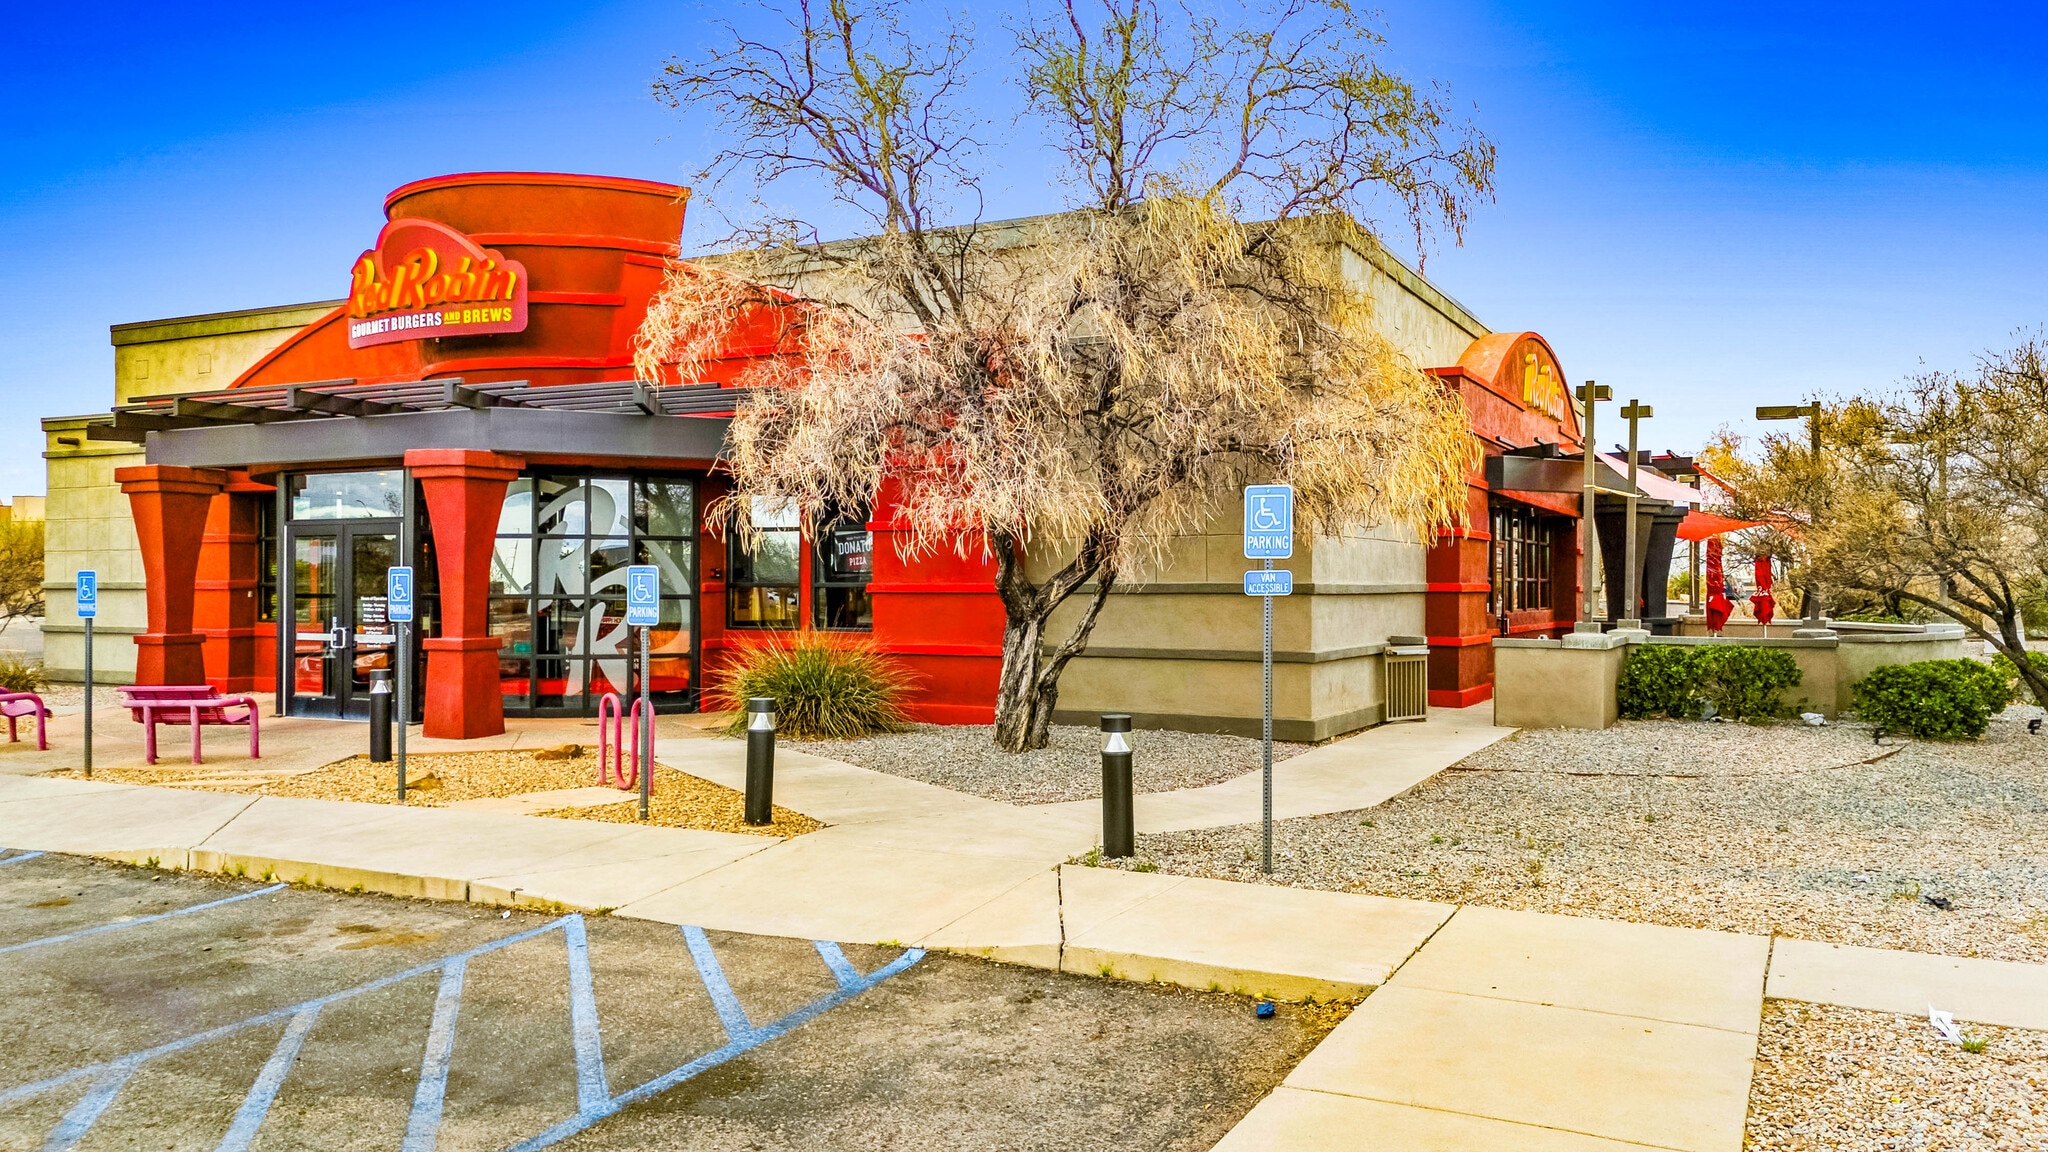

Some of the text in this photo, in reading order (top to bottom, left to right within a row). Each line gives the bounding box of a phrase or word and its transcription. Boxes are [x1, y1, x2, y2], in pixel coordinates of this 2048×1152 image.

[397, 247, 517, 310] Robin
[352, 307, 513, 339] GOURMET BURGERS AND BREWS
[838, 540, 872, 555] DONATO
[1247, 535, 1289, 550] PARKING
[849, 556, 867, 566] PIZZA
[1260, 573, 1277, 583] VAN
[1248, 583, 1289, 593] ACCESSIBLE
[389, 604, 411, 614] PARKING
[629, 606, 658, 618] PARKING
